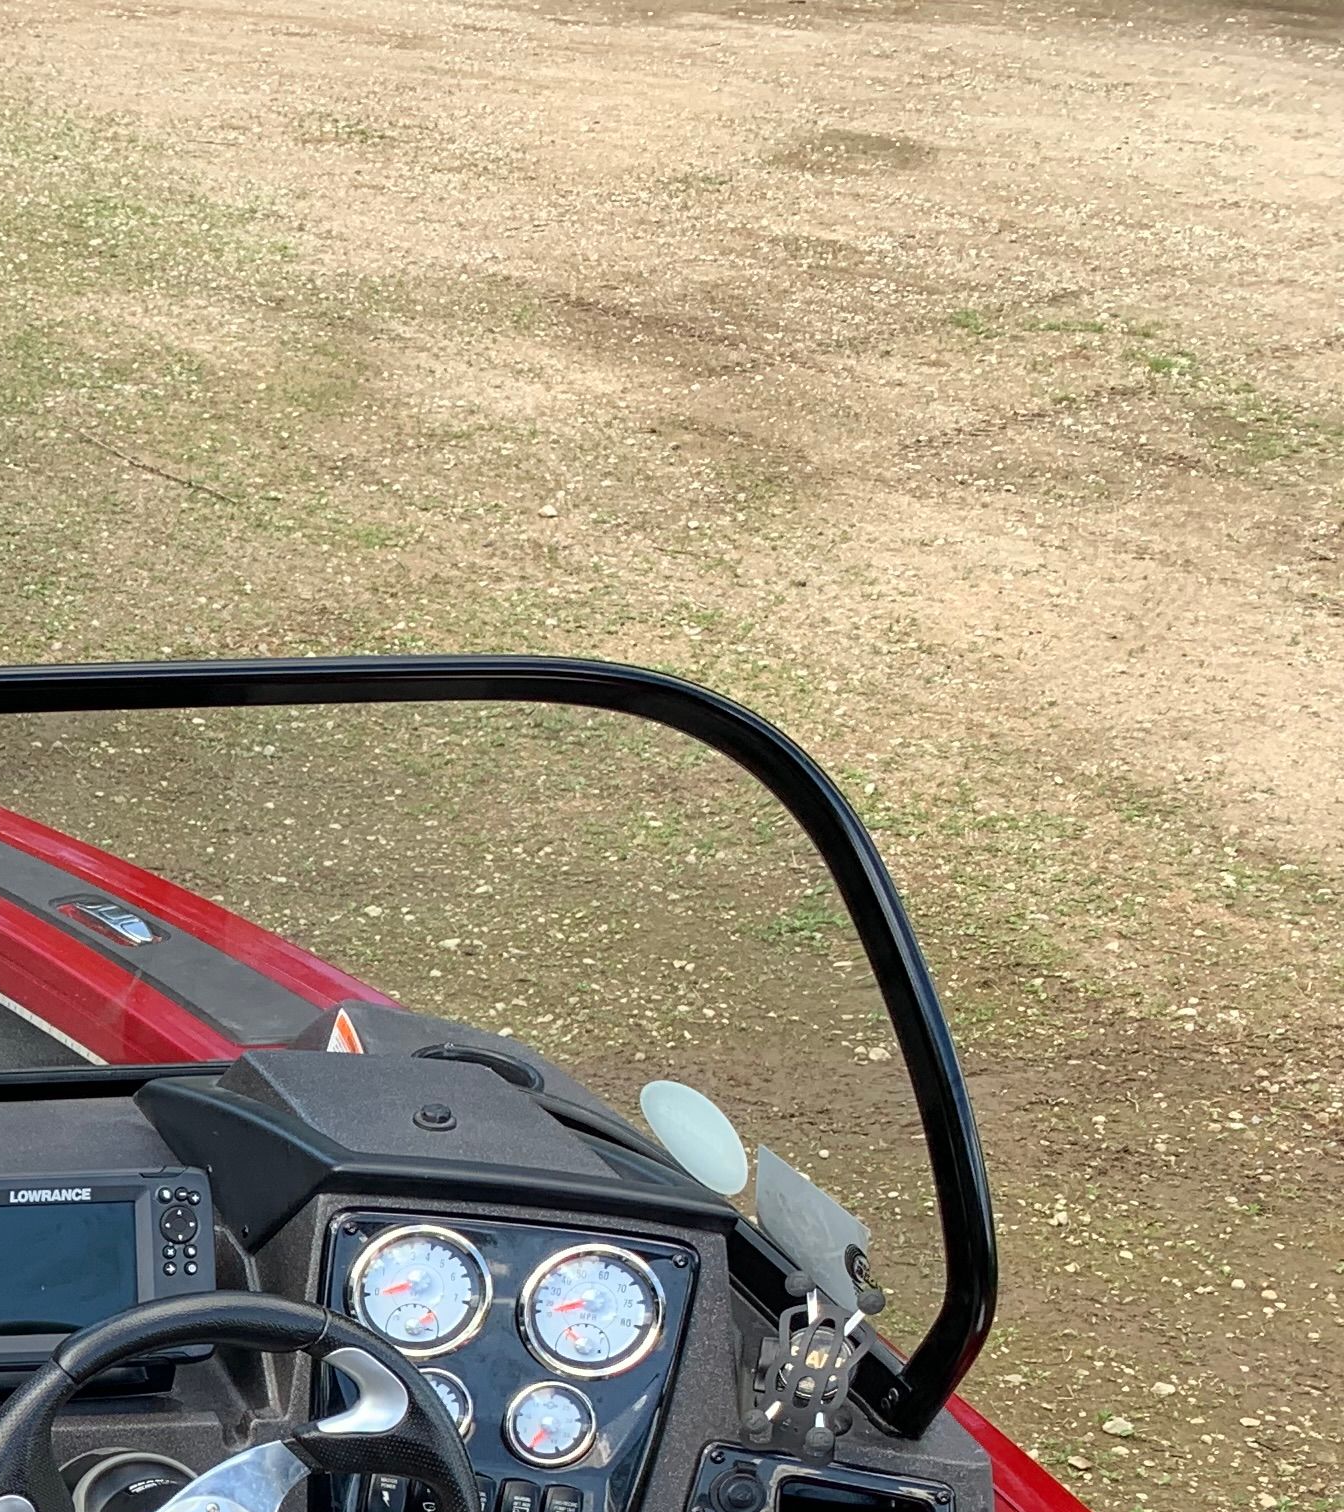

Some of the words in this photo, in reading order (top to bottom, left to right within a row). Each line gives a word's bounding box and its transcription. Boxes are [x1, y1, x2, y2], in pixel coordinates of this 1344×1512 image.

[9, 1187, 92, 1204] LOWRANCE
[425, 1252, 432, 1262] 4
[439, 1258, 445, 1269] 5
[450, 1272, 456, 1282] 6
[576, 1270, 587, 1280] 50
[598, 1271, 610, 1281] 60
[561, 1276, 572, 1286] 40
[374, 1287, 380, 1296] 0
[551, 1286, 562, 1297] 30
[616, 1283, 627, 1294] 70
[454, 1293, 459, 1302] 7
[622, 1299, 633, 1309] 75
[579, 1312, 598, 1321] MPH
[619, 1318, 631, 1328] 80
